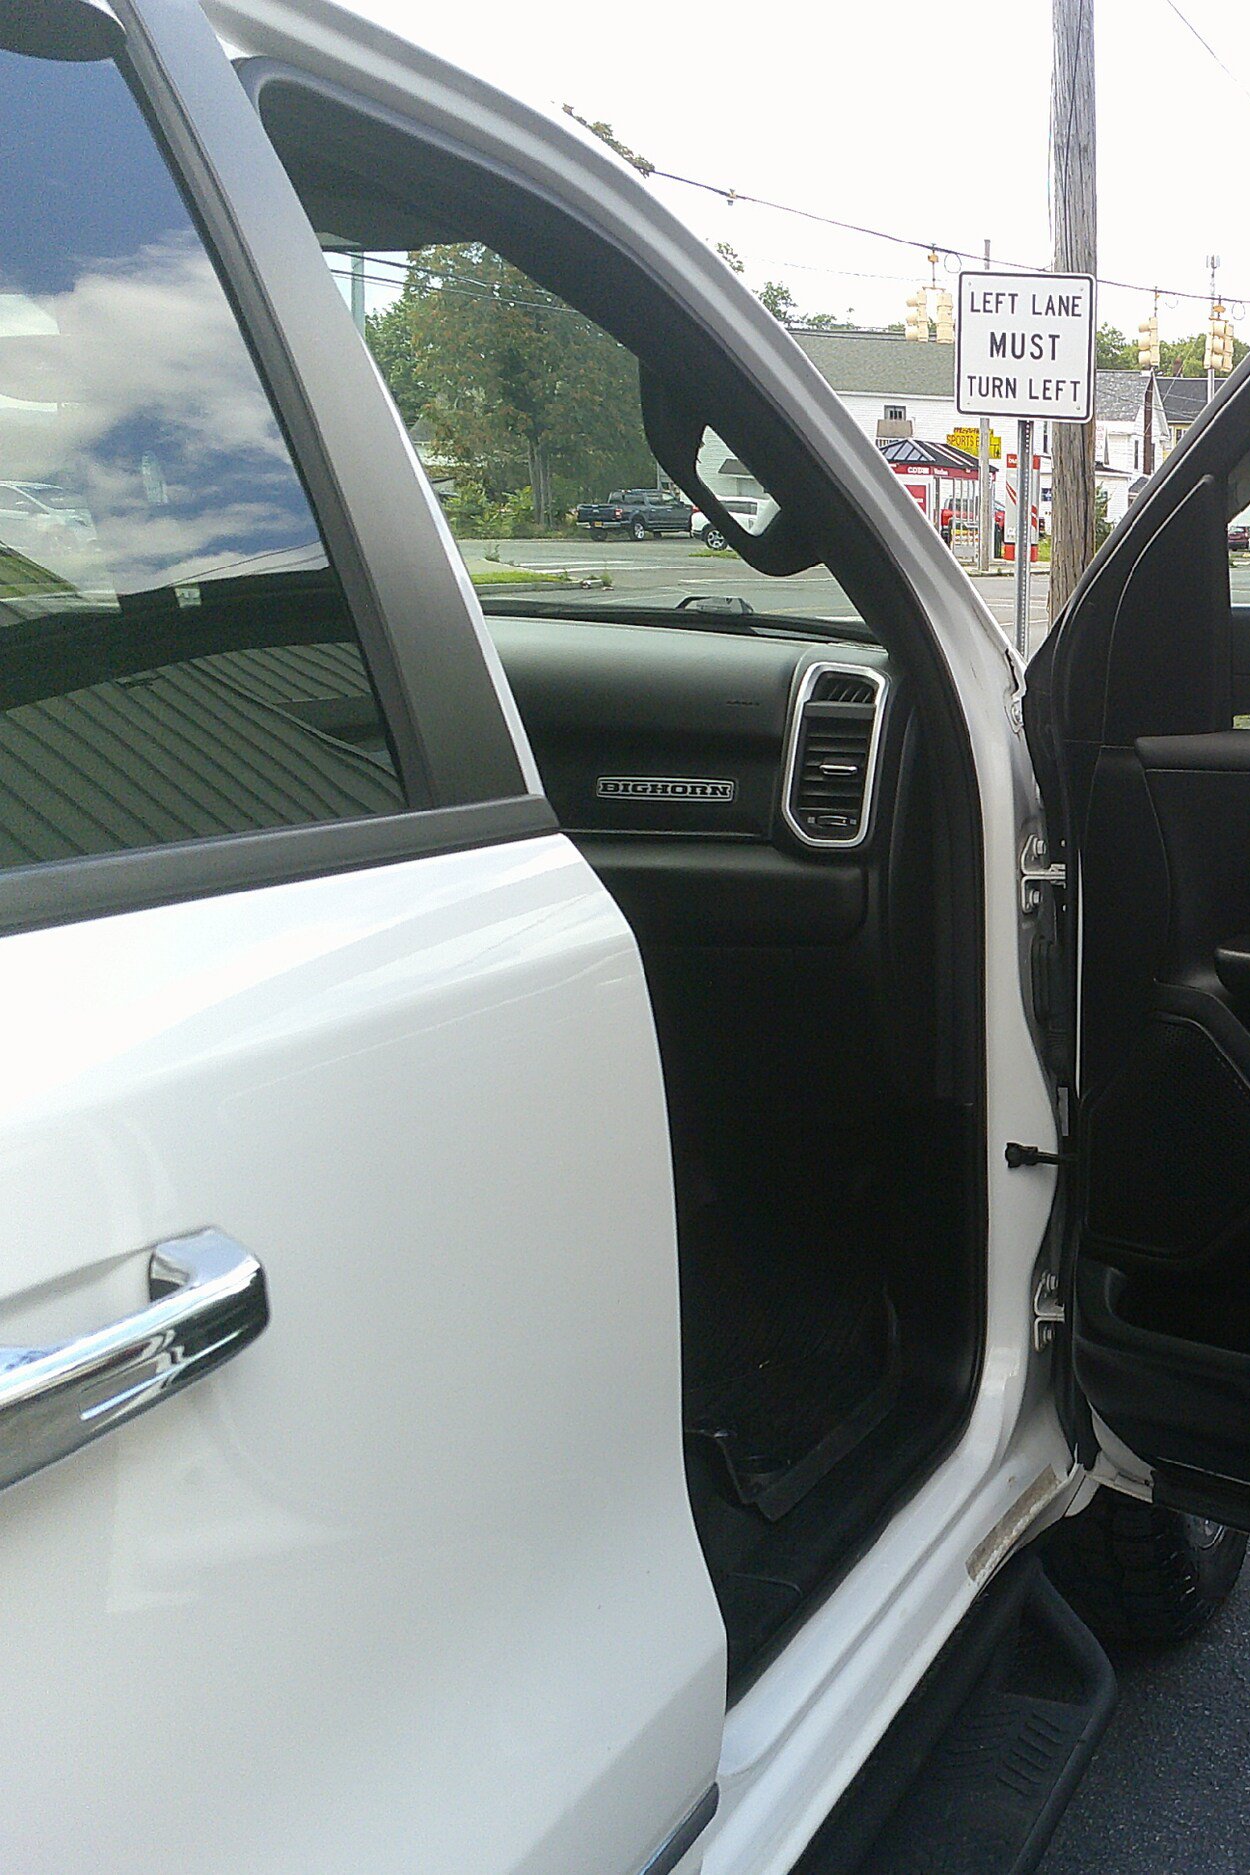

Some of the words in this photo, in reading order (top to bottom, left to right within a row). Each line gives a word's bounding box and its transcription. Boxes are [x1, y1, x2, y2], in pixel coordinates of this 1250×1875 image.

[969, 291, 1018, 314] LEFT
[1031, 293, 1083, 318] LANE
[989, 331, 1061, 361] MUST
[967, 375, 1017, 400] TURN
[1028, 378, 1081, 403] LEFT
[946, 434, 974, 447] SPORTS
[600, 782, 730, 797] BIGHORN
